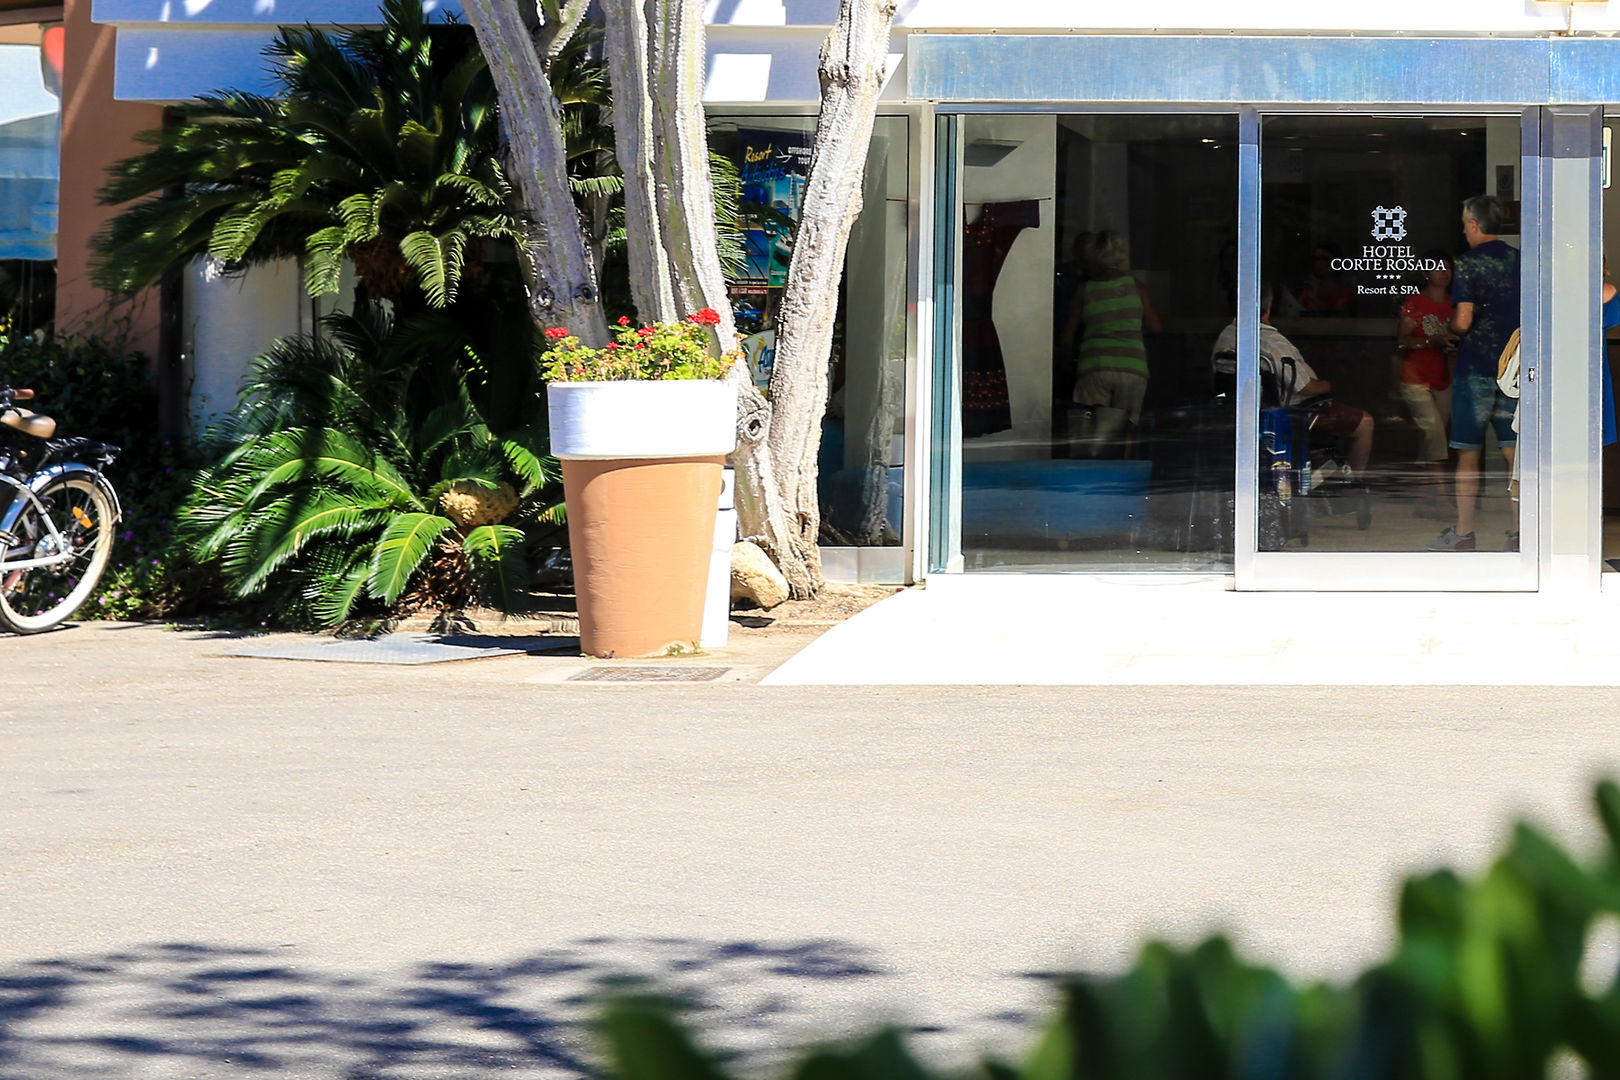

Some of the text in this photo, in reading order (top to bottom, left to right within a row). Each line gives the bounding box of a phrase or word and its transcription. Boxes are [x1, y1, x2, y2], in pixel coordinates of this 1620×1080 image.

[744, 144, 773, 163] Resort
[1363, 246, 1415, 258] HOTEL
[1331, 259, 1446, 271] CORTE ROSADA
[1357, 285, 1420, 295] Resort & SPA
